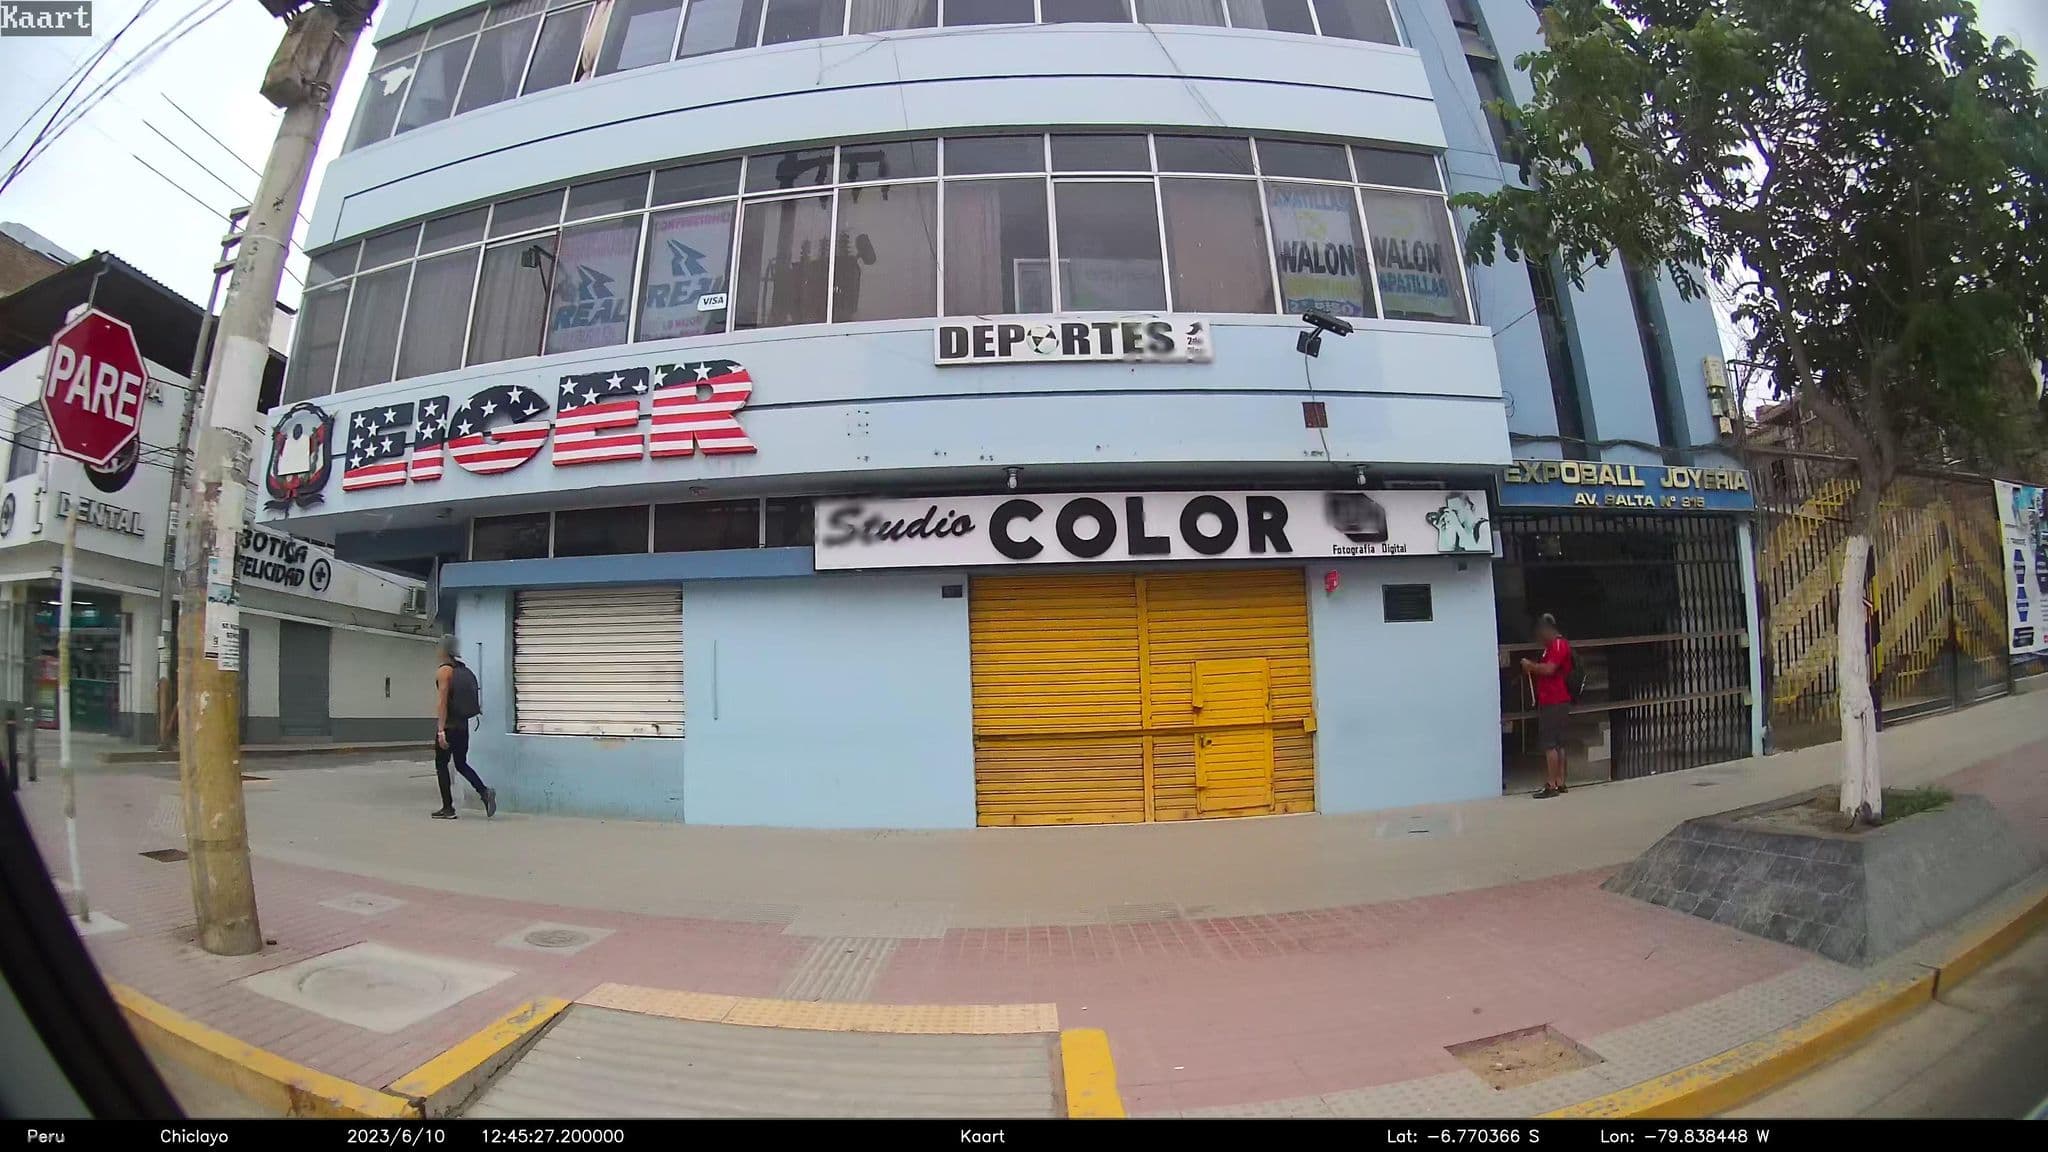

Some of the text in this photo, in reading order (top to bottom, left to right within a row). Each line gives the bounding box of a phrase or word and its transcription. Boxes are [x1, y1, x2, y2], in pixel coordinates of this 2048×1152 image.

[1277, 240, 1356, 276] WALON
[553, 298, 628, 332] REAL
[702, 296, 724, 306] VISA
[938, 321, 1175, 359] DEPORTES
[47, 344, 142, 427] PARE
[342, 359, 758, 491] EIGER
[1504, 461, 1749, 491] EXPOBALL JOYERIA
[57, 491, 145, 539] DENTAL
[1574, 492, 1600, 506] AV.
[823, 495, 1293, 560] Studio COLOR
[240, 528, 309, 564] BOTICA
[1382, 543, 1407, 555] Digital
[240, 555, 305, 587] FELICIDAD
